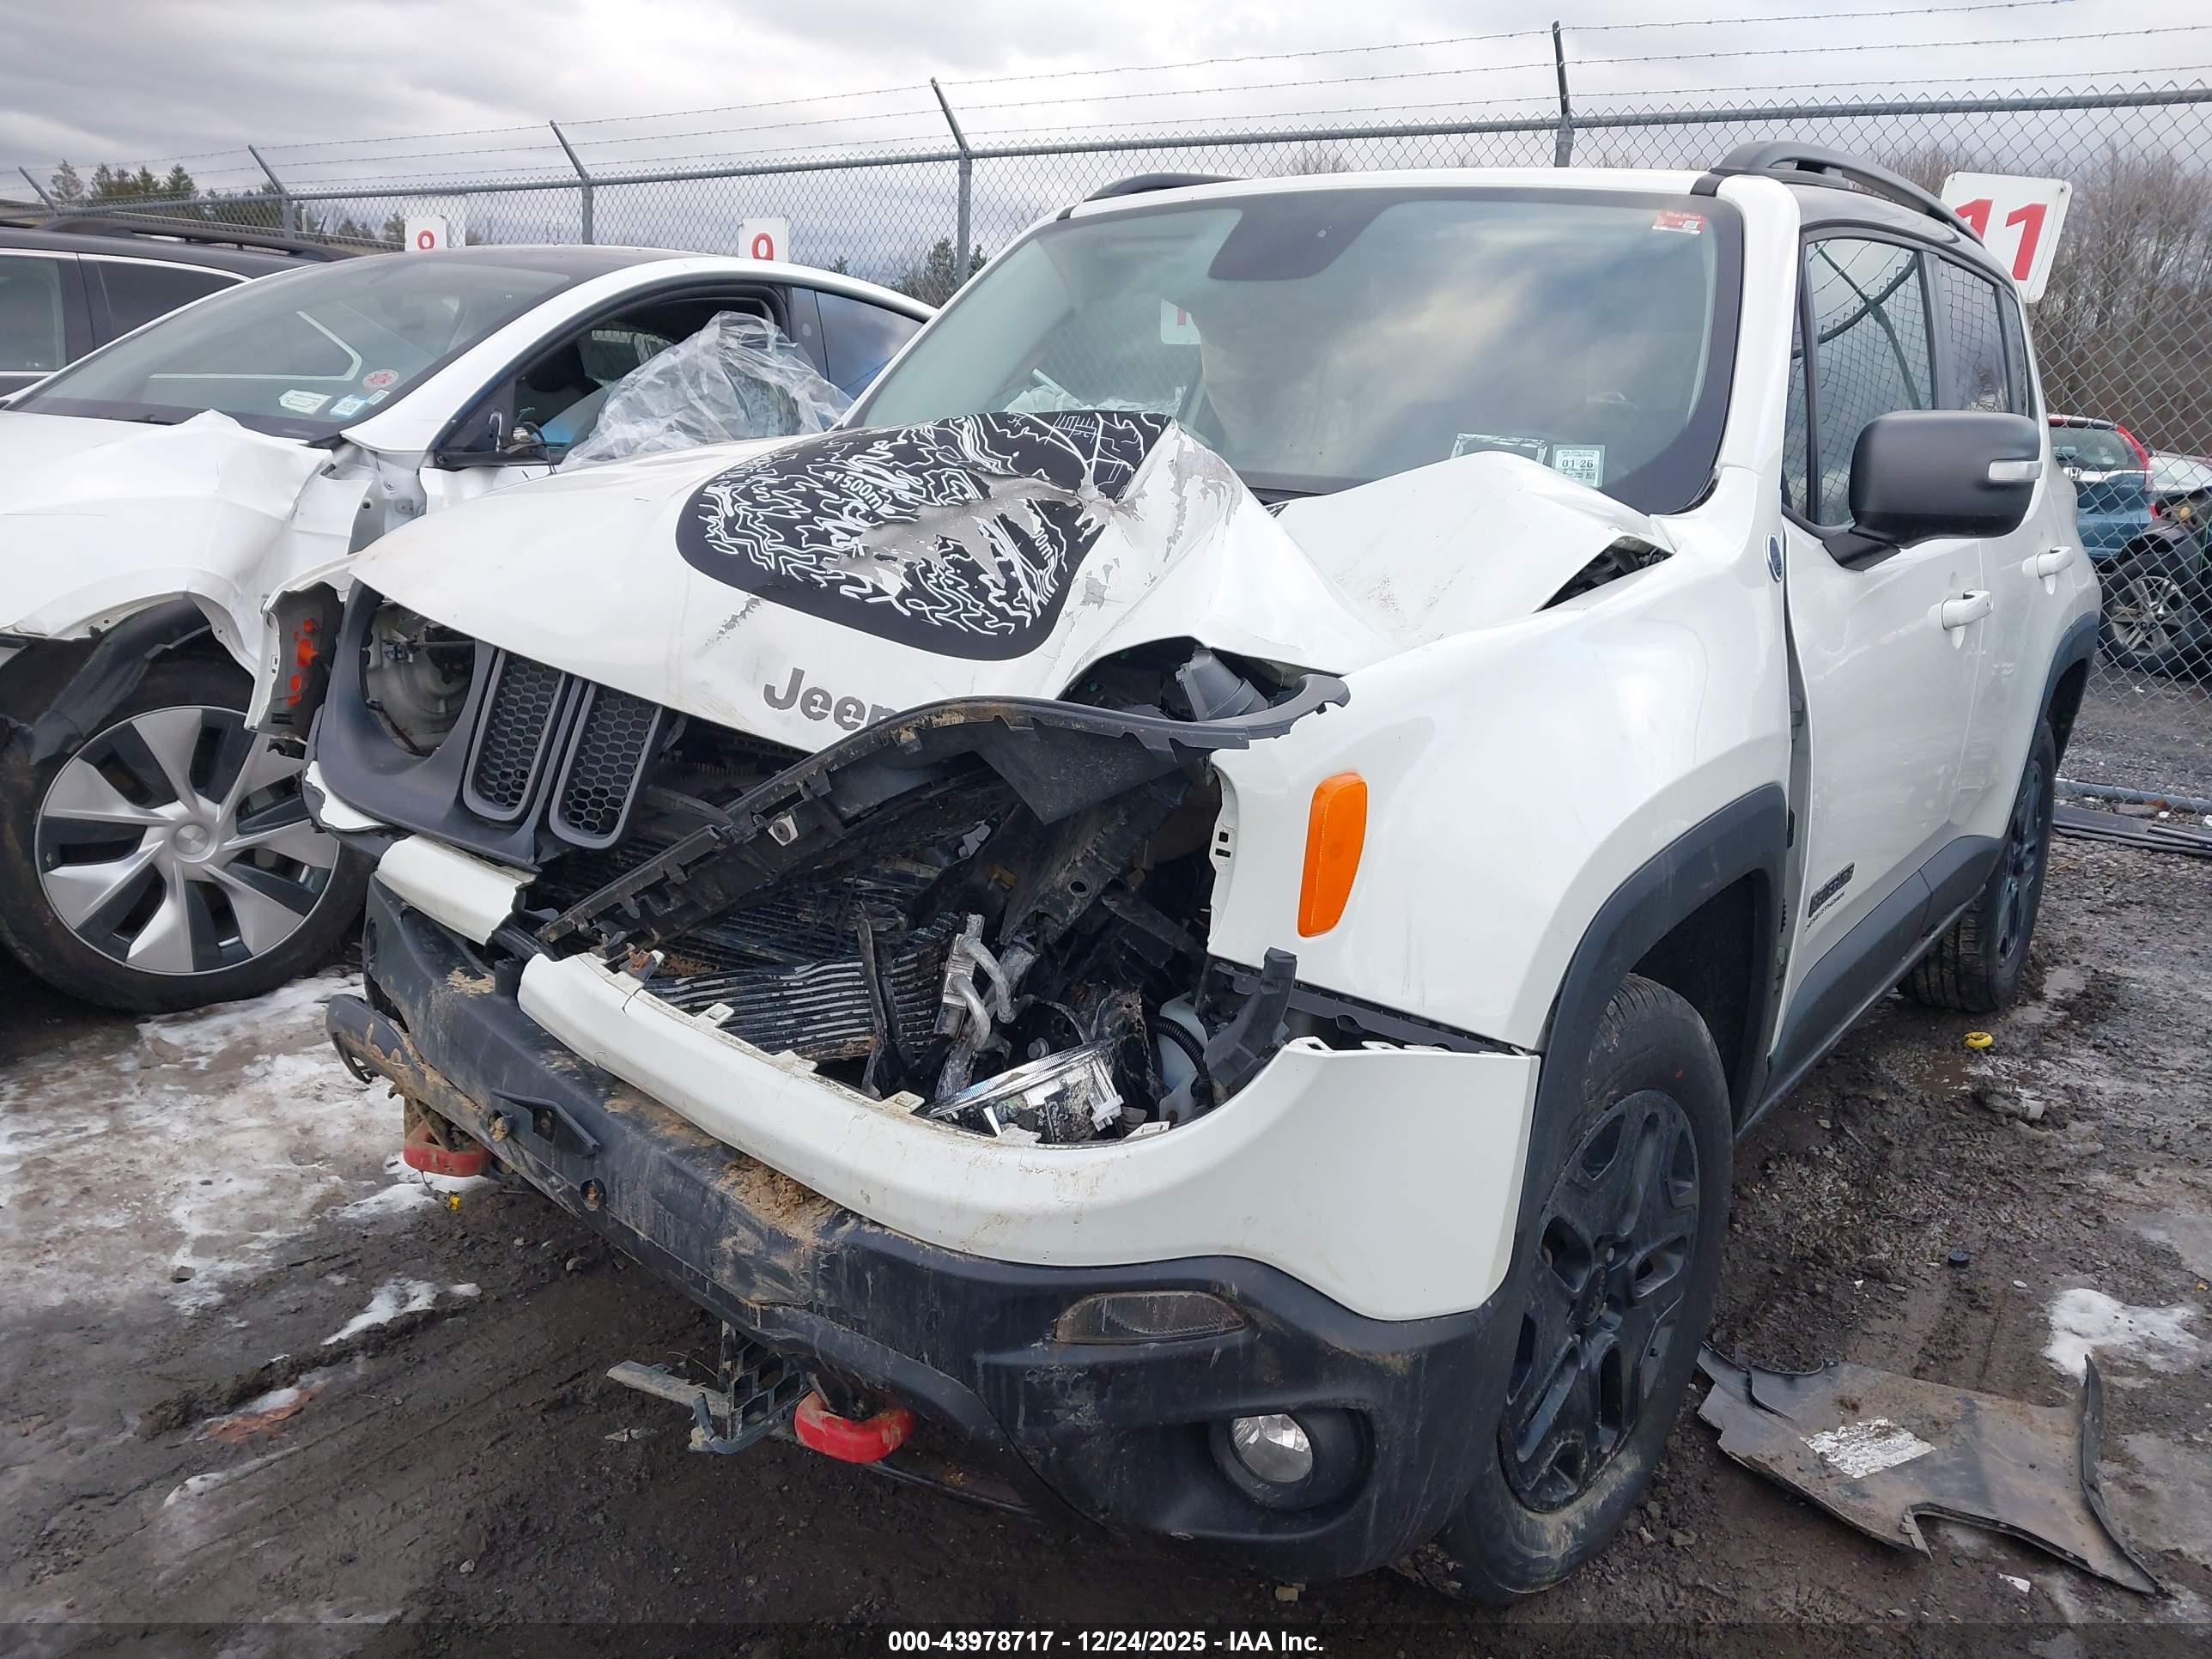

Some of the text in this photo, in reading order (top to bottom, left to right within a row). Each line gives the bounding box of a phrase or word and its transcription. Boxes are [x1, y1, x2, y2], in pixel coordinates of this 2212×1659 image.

[1562, 459, 1594, 468] 01 26
[832, 473, 883, 509] 1500m
